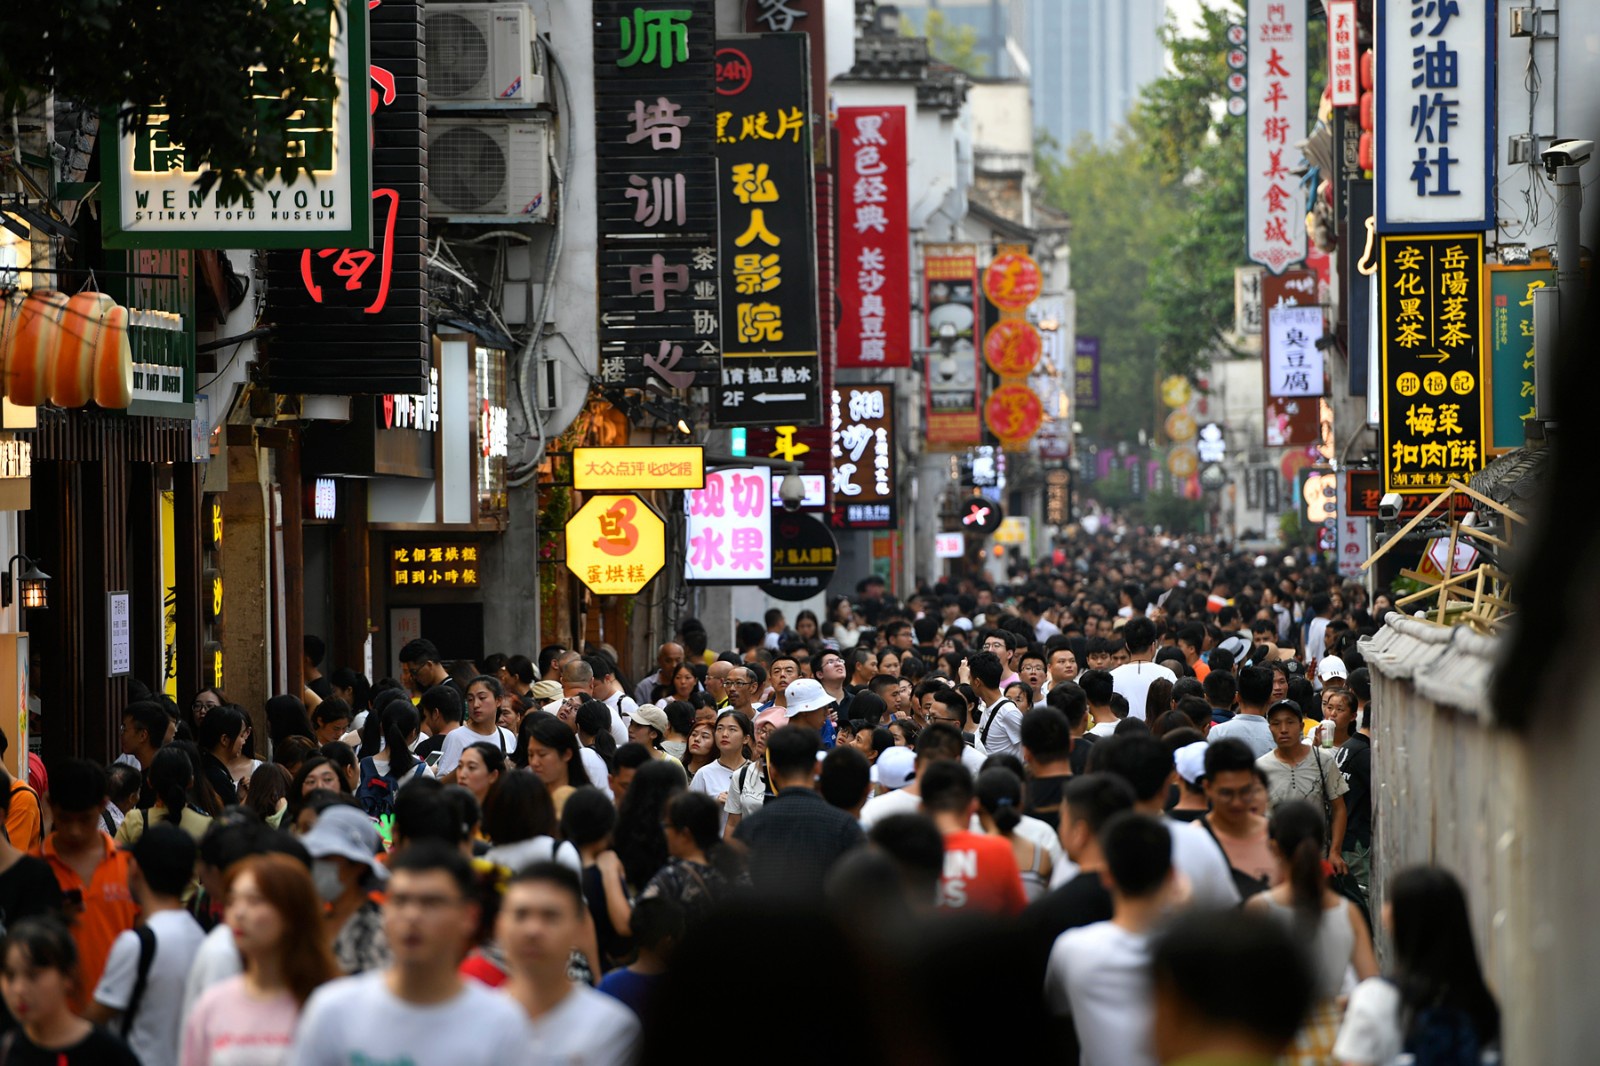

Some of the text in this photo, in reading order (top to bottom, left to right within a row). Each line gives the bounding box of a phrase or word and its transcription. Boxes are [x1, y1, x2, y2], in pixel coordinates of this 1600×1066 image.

[1410, 0, 1461, 197] 沙油炸社
[1263, 47, 1292, 247] 太平街美食城
[135, 211, 335, 220] STINKY TOFU MUSEUM
[616, 8, 696, 396] 师培训中心
[732, 163, 784, 345] 私人影院
[853, 114, 889, 363] 黑色经典 长沙臭豆腐
[1394, 246, 1427, 348] 安化黑茶
[1440, 244, 1472, 348] 岳陽茗茶
[1281, 327, 1312, 392] 臭豆腐
[722, 391, 745, 408] 2F
[1405, 403, 1463, 437] 梅菜
[585, 461, 692, 477] 大众点评 必吃榜
[1392, 440, 1477, 473] 扣肉餅
[690, 473, 764, 518] 现切
[394, 547, 477, 563] 吃個蛋烘糕
[690, 527, 764, 571] 水果
[394, 569, 477, 584] 回到小時候
[587, 564, 646, 583] 蛋烘糕
